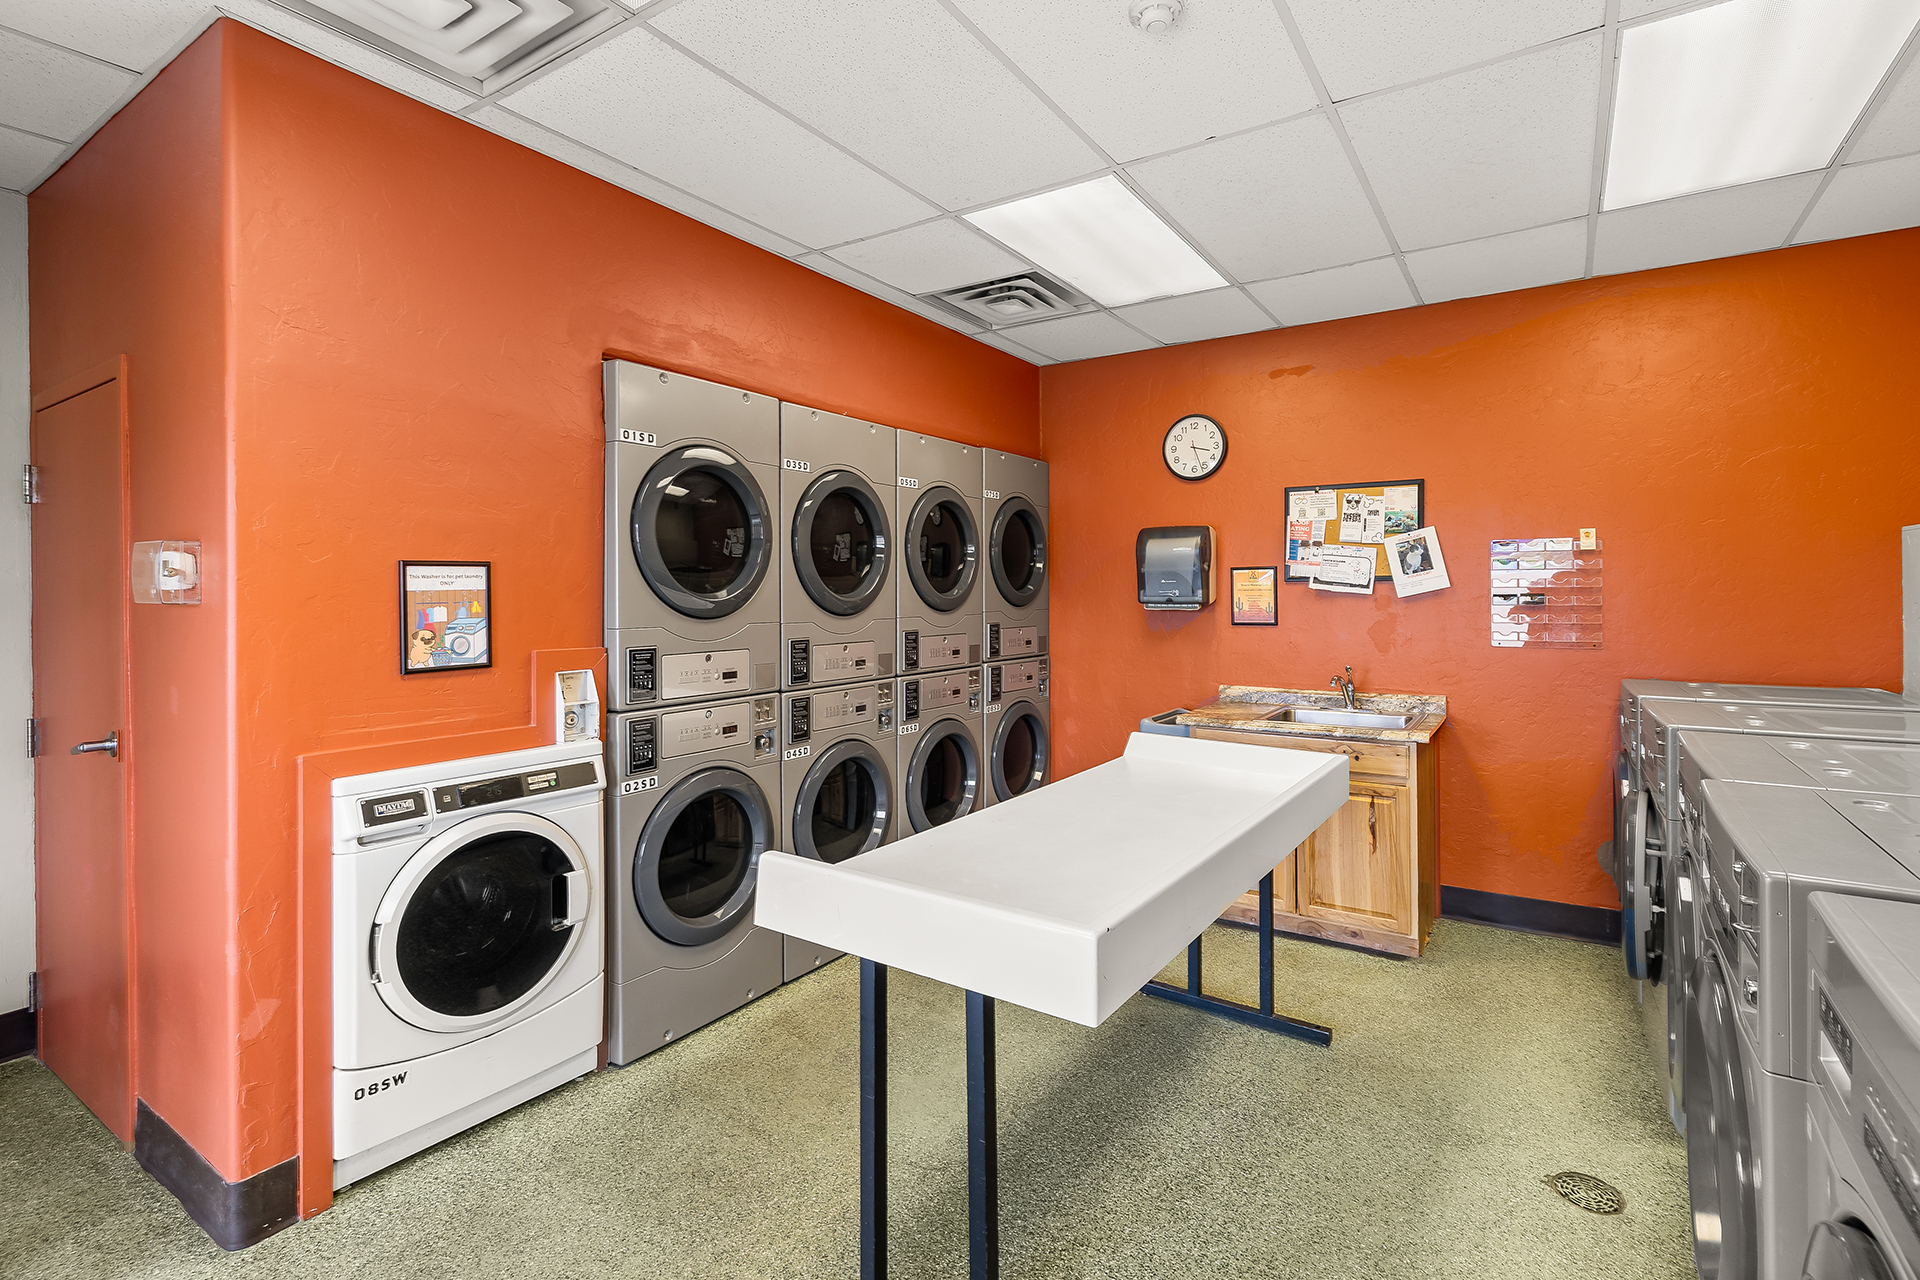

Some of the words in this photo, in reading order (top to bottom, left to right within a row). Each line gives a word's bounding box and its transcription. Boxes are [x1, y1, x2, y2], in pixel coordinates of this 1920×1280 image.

[1190, 422, 1199, 430] 12
[622, 430, 655, 443] 01SD
[1209, 431, 1215, 439] 2
[1171, 445, 1177, 453] 9
[1213, 441, 1220, 449] 3
[1174, 456, 1180, 464] 8
[785, 459, 809, 470] 03SD
[1202, 461, 1208, 469] 5
[1191, 465, 1198, 473] 6
[786, 747, 809, 759] 04SD
[624, 777, 656, 793] 02SD
[377, 800, 412, 813] MAYTAG
[354, 1070, 409, 1101] 08SW
